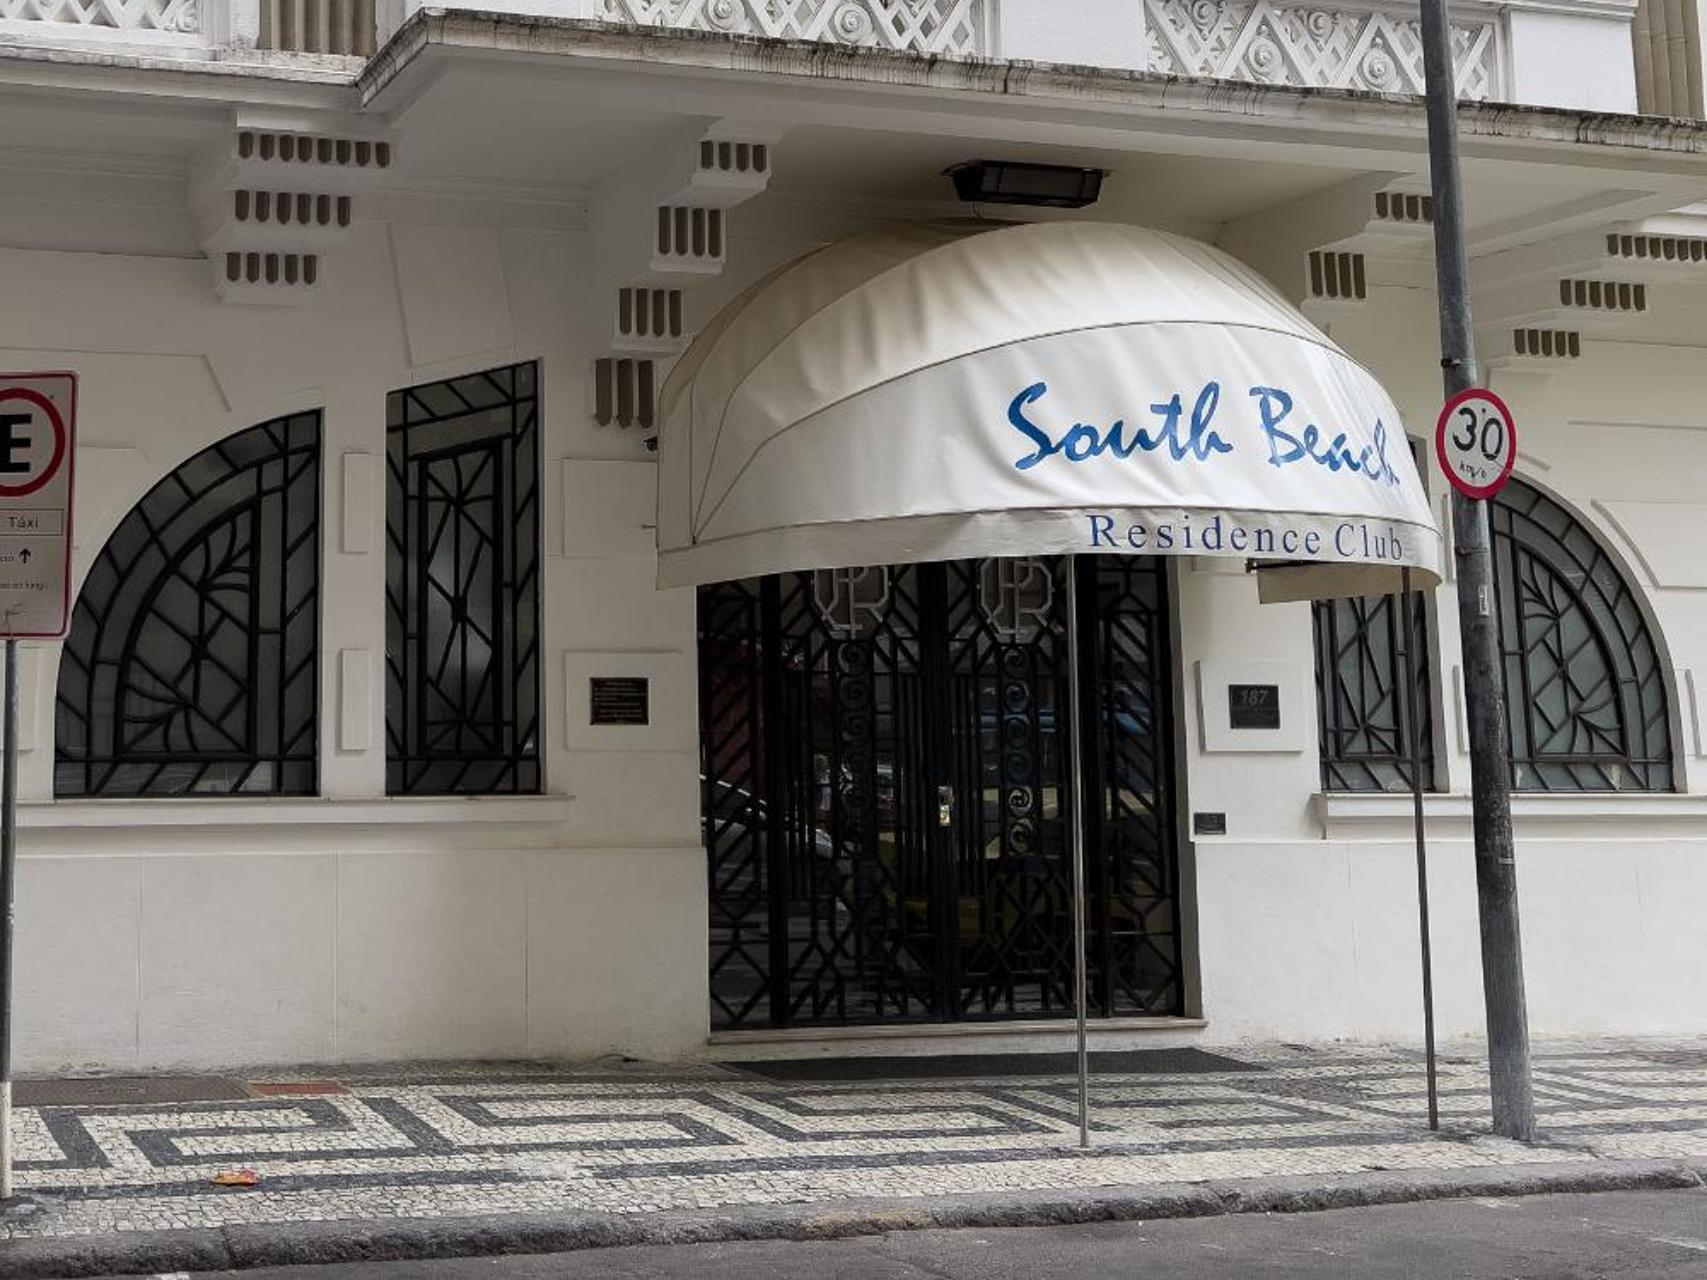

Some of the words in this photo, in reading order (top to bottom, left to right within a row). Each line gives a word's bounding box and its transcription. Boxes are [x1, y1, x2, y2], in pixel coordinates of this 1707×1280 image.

[0, 413, 32, 473] E
[1007, 381, 1232, 470] South
[1248, 386, 1400, 485] Beach
[1452, 407, 1503, 461] 30
[1086, 514, 1321, 555] Residence
[1335, 523, 1403, 561] Club
